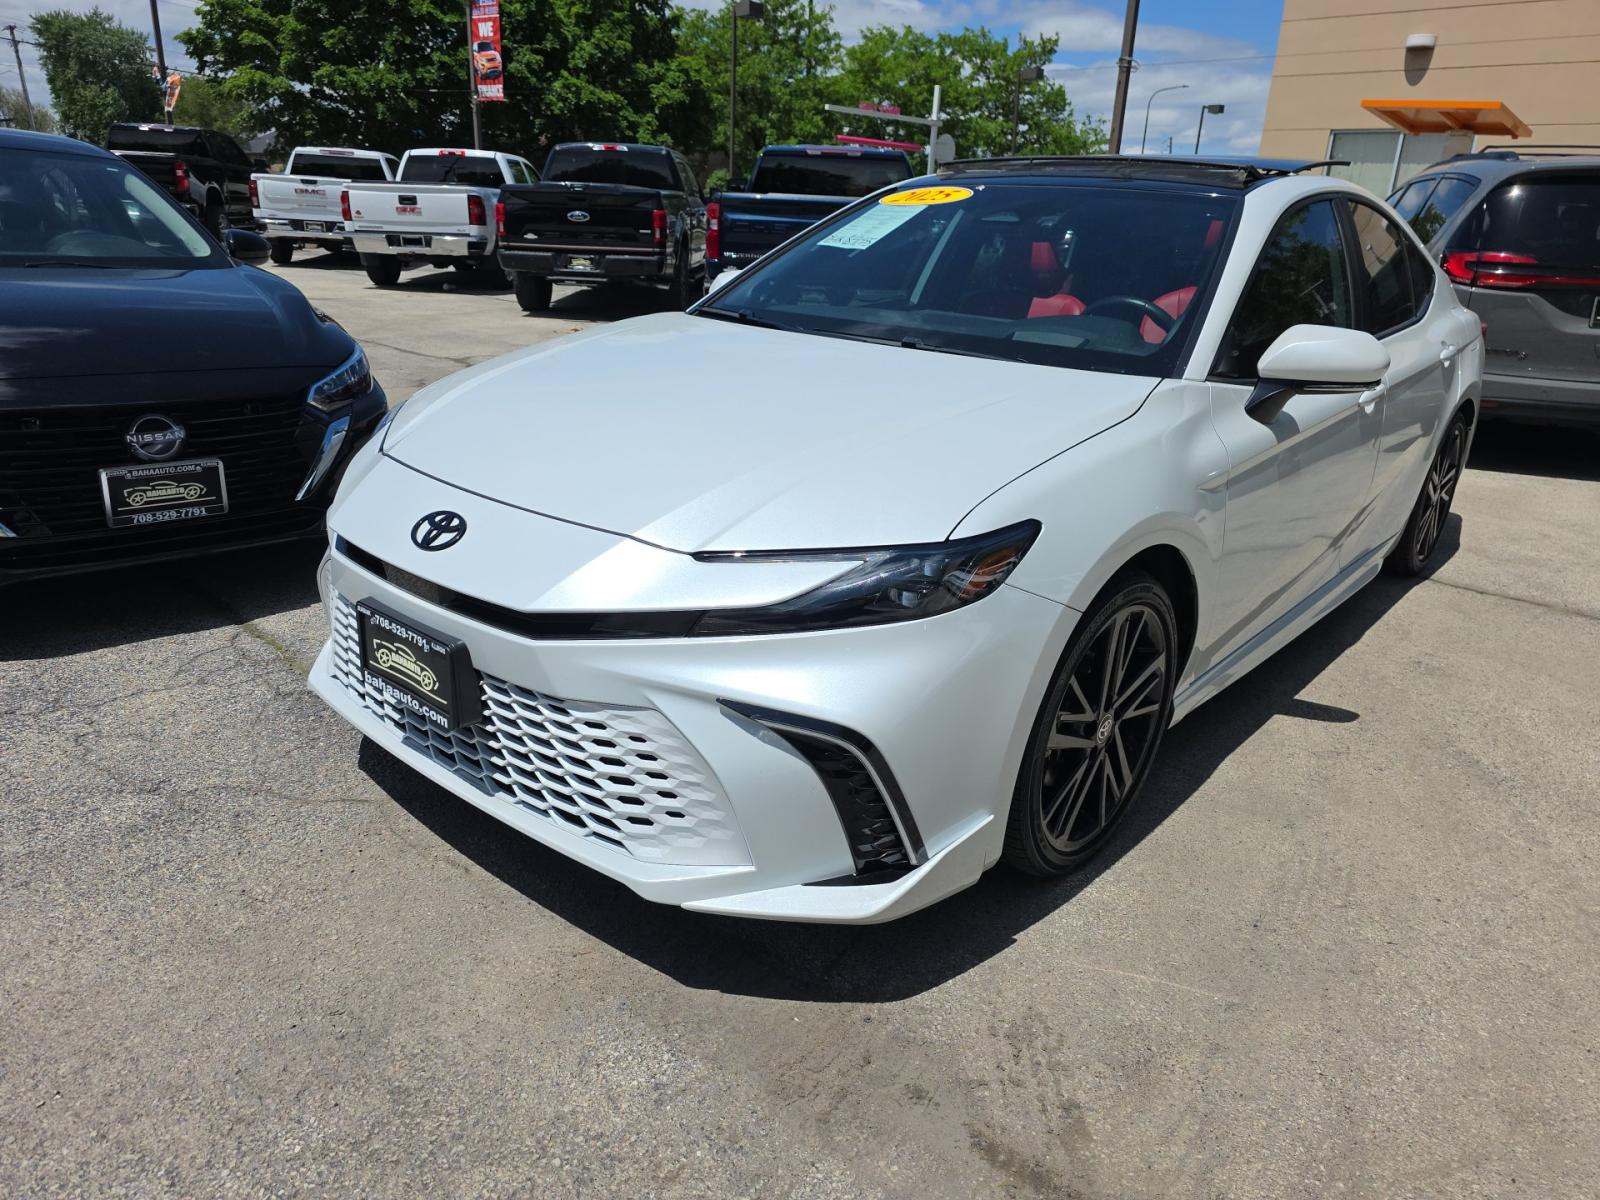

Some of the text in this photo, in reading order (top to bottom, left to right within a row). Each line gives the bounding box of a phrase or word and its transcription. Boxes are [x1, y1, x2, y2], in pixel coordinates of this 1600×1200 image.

[478, 21, 494, 37] WE
[126, 431, 184, 443] NISSAN
[132, 465, 196, 477] BAHAAUTO.COM
[146, 486, 185, 498] BAHAAUTO
[133, 507, 208, 525] 708-529-7791
[375, 614, 428, 648] 708-529-7791
[364, 670, 449, 728] bahaauto.com
